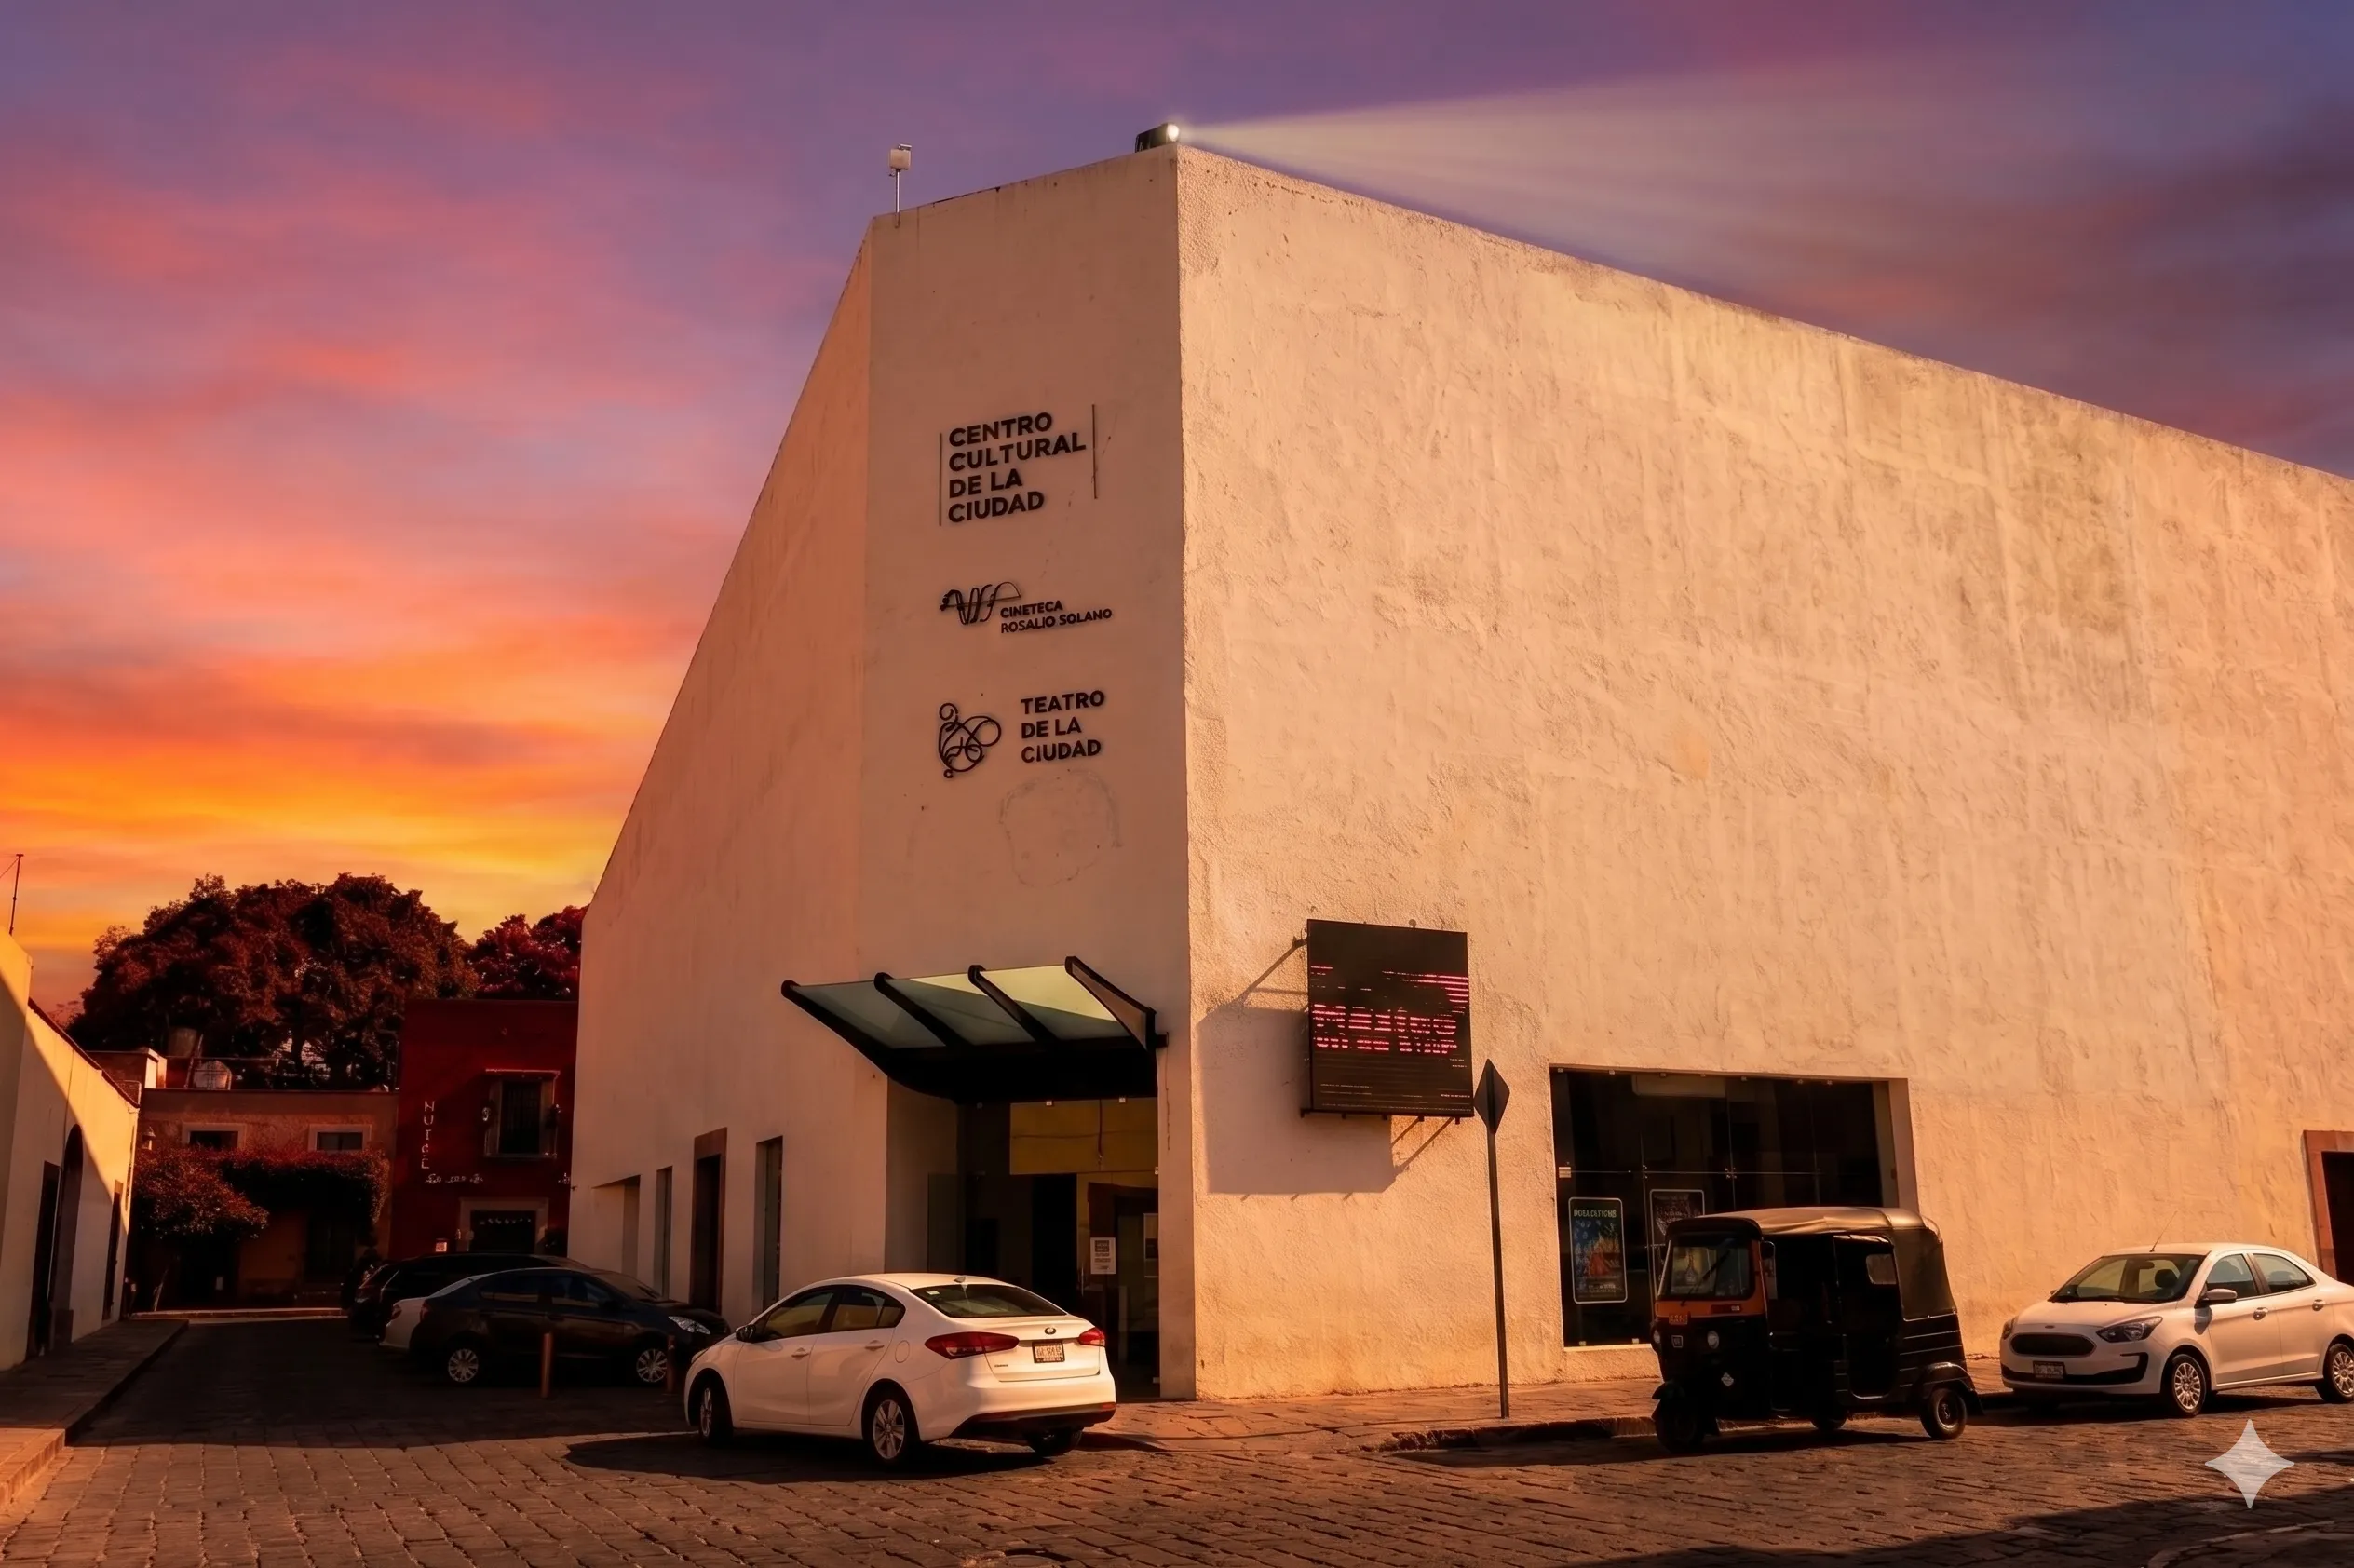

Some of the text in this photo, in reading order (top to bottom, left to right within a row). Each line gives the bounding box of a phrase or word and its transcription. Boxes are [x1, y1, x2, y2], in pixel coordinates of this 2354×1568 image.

[949, 412, 1053, 447] CENTRO
[949, 432, 1087, 472] CULTURAL
[949, 468, 1023, 498] DE LA
[948, 491, 1045, 523] CIUDAD
[1000, 601, 1063, 618] CINETECA
[1001, 608, 1112, 634] ROSALIO SOLANO
[1021, 690, 1105, 714] TEATRO
[1021, 716, 1083, 738] DE LA
[1021, 739, 1102, 763] CIUDAD
